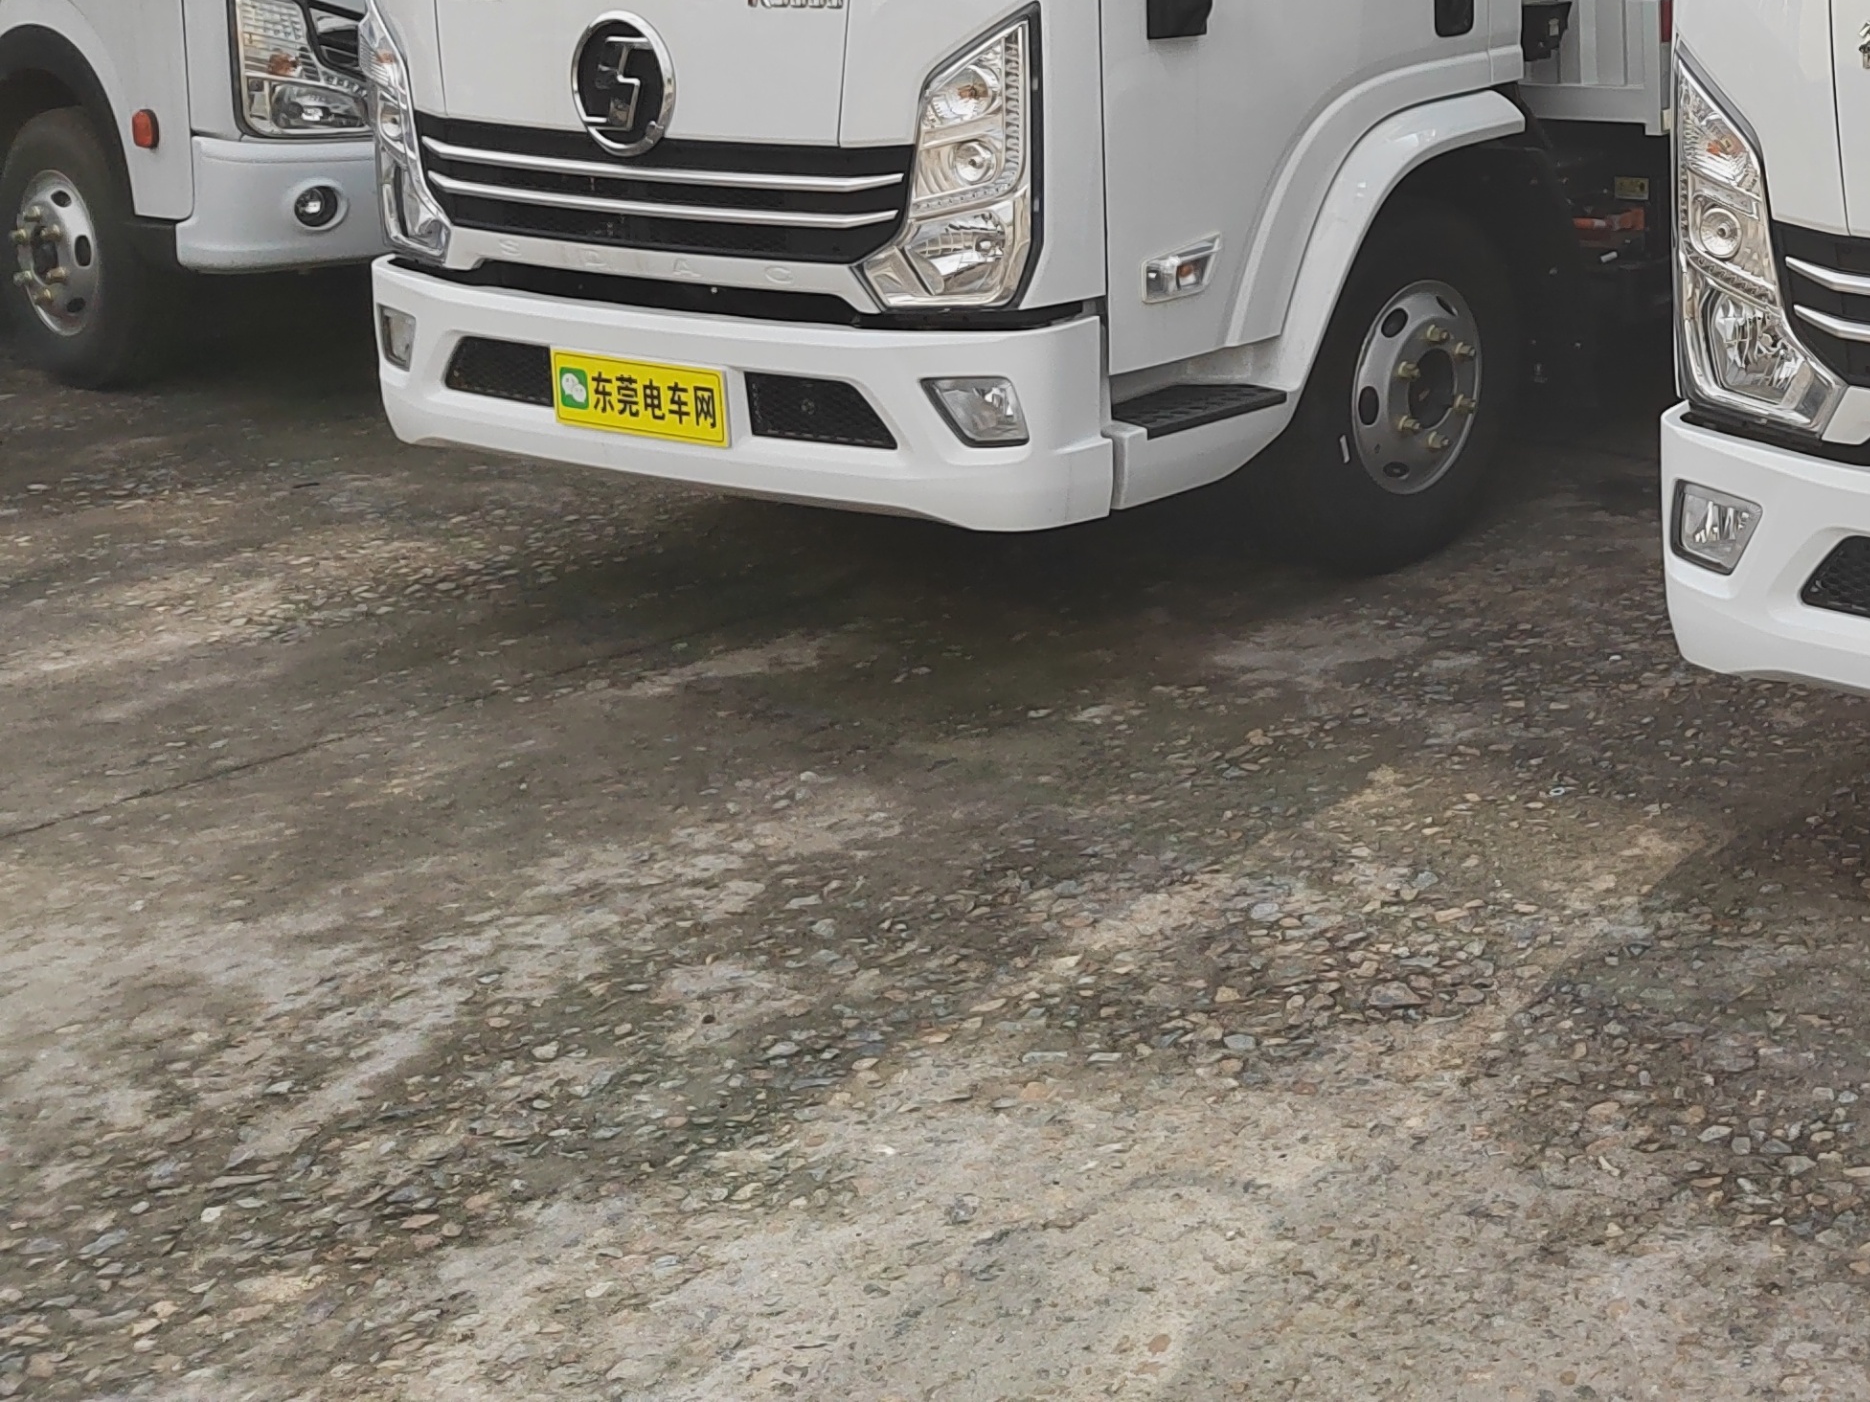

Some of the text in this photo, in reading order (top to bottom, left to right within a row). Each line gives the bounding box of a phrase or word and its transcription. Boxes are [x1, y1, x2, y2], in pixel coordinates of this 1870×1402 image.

[591, 371, 717, 429] 东莞电车网
